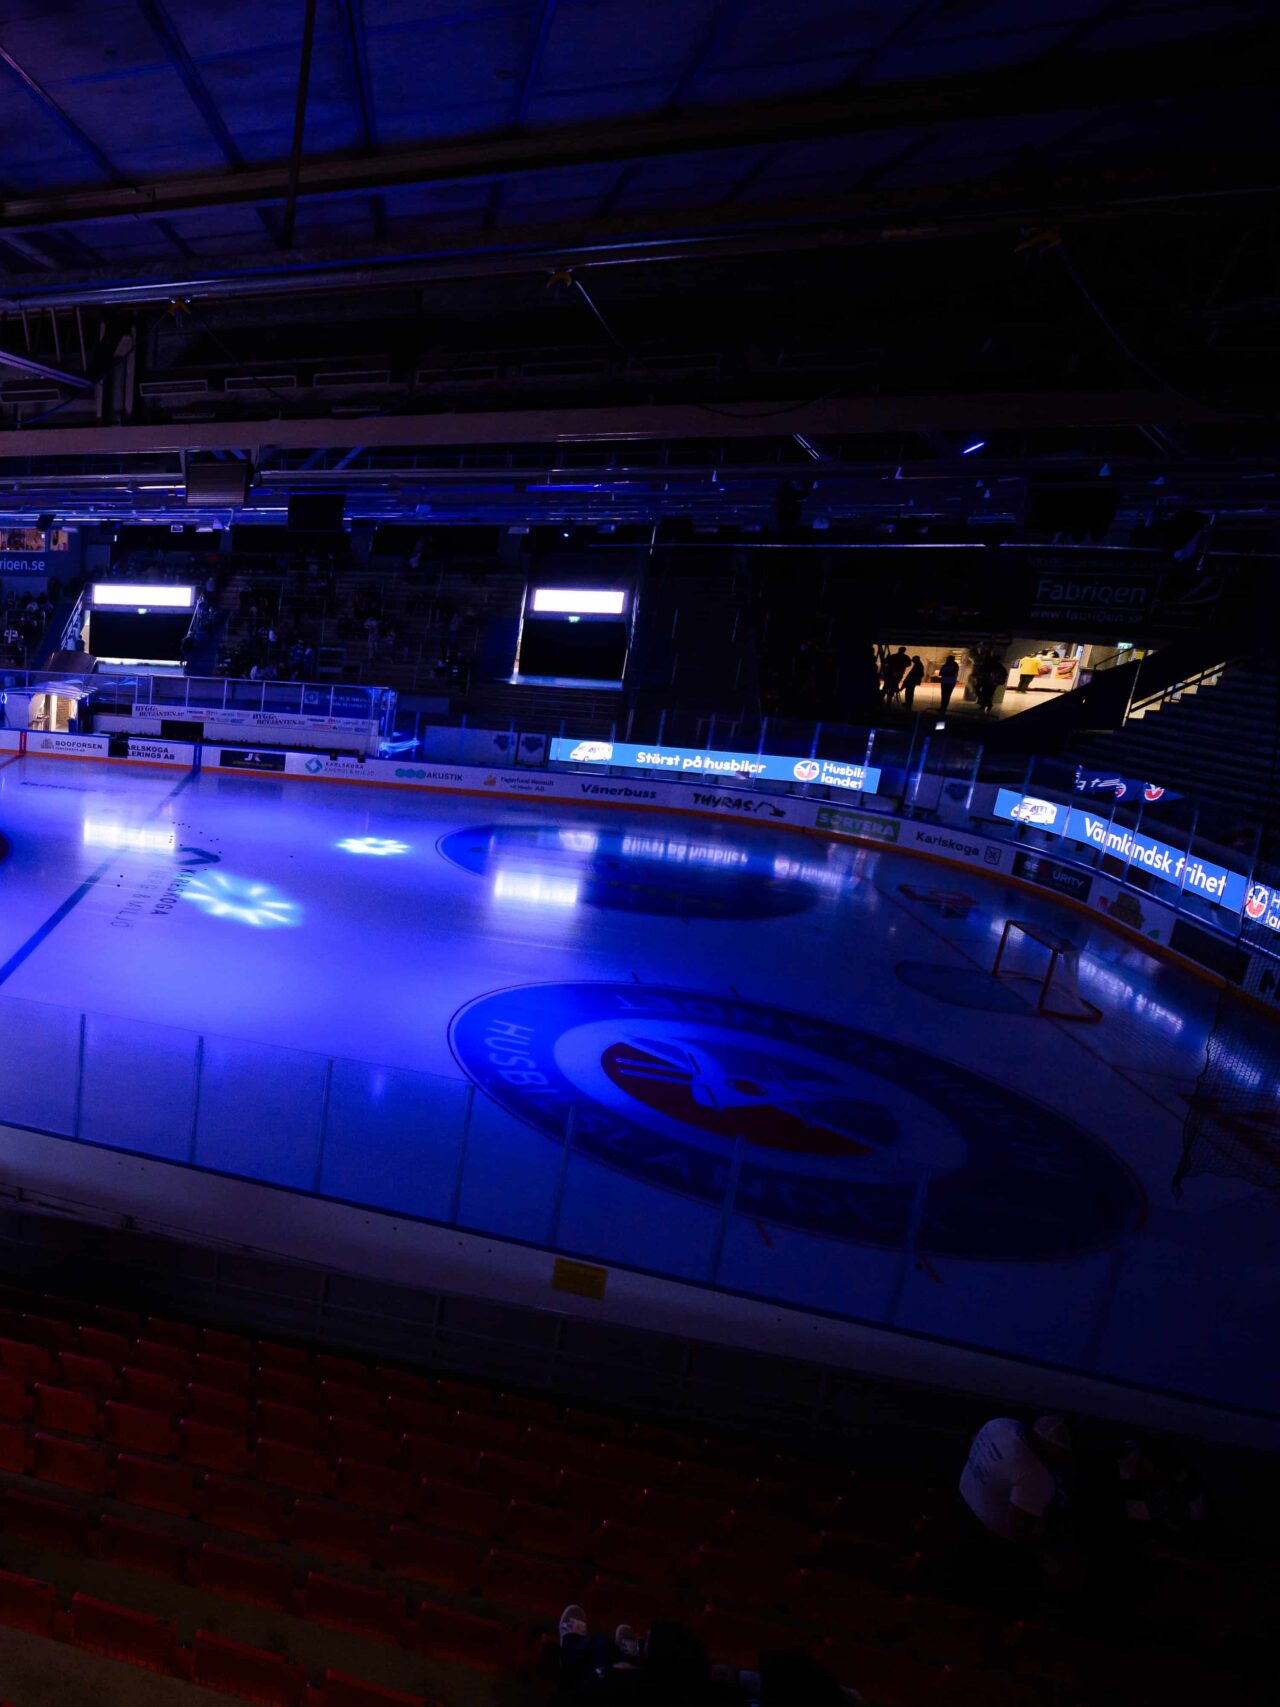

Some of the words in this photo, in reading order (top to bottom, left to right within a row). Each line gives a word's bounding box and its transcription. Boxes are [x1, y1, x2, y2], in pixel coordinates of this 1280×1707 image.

[636, 750, 681, 767] Störst
[682, 754, 702, 770] på
[703, 756, 767, 774] husbilar
[823, 761, 868, 779] Husbils
[426, 771, 463, 781] AKUSTIK
[821, 771, 865, 790] landet
[581, 783, 657, 799] Vänerbuss
[693, 792, 753, 812] THYRAS
[916, 830, 980, 857] Karlskoga
[1084, 816, 1170, 874] Värmländsk
[1175, 857, 1227, 897] frihet
